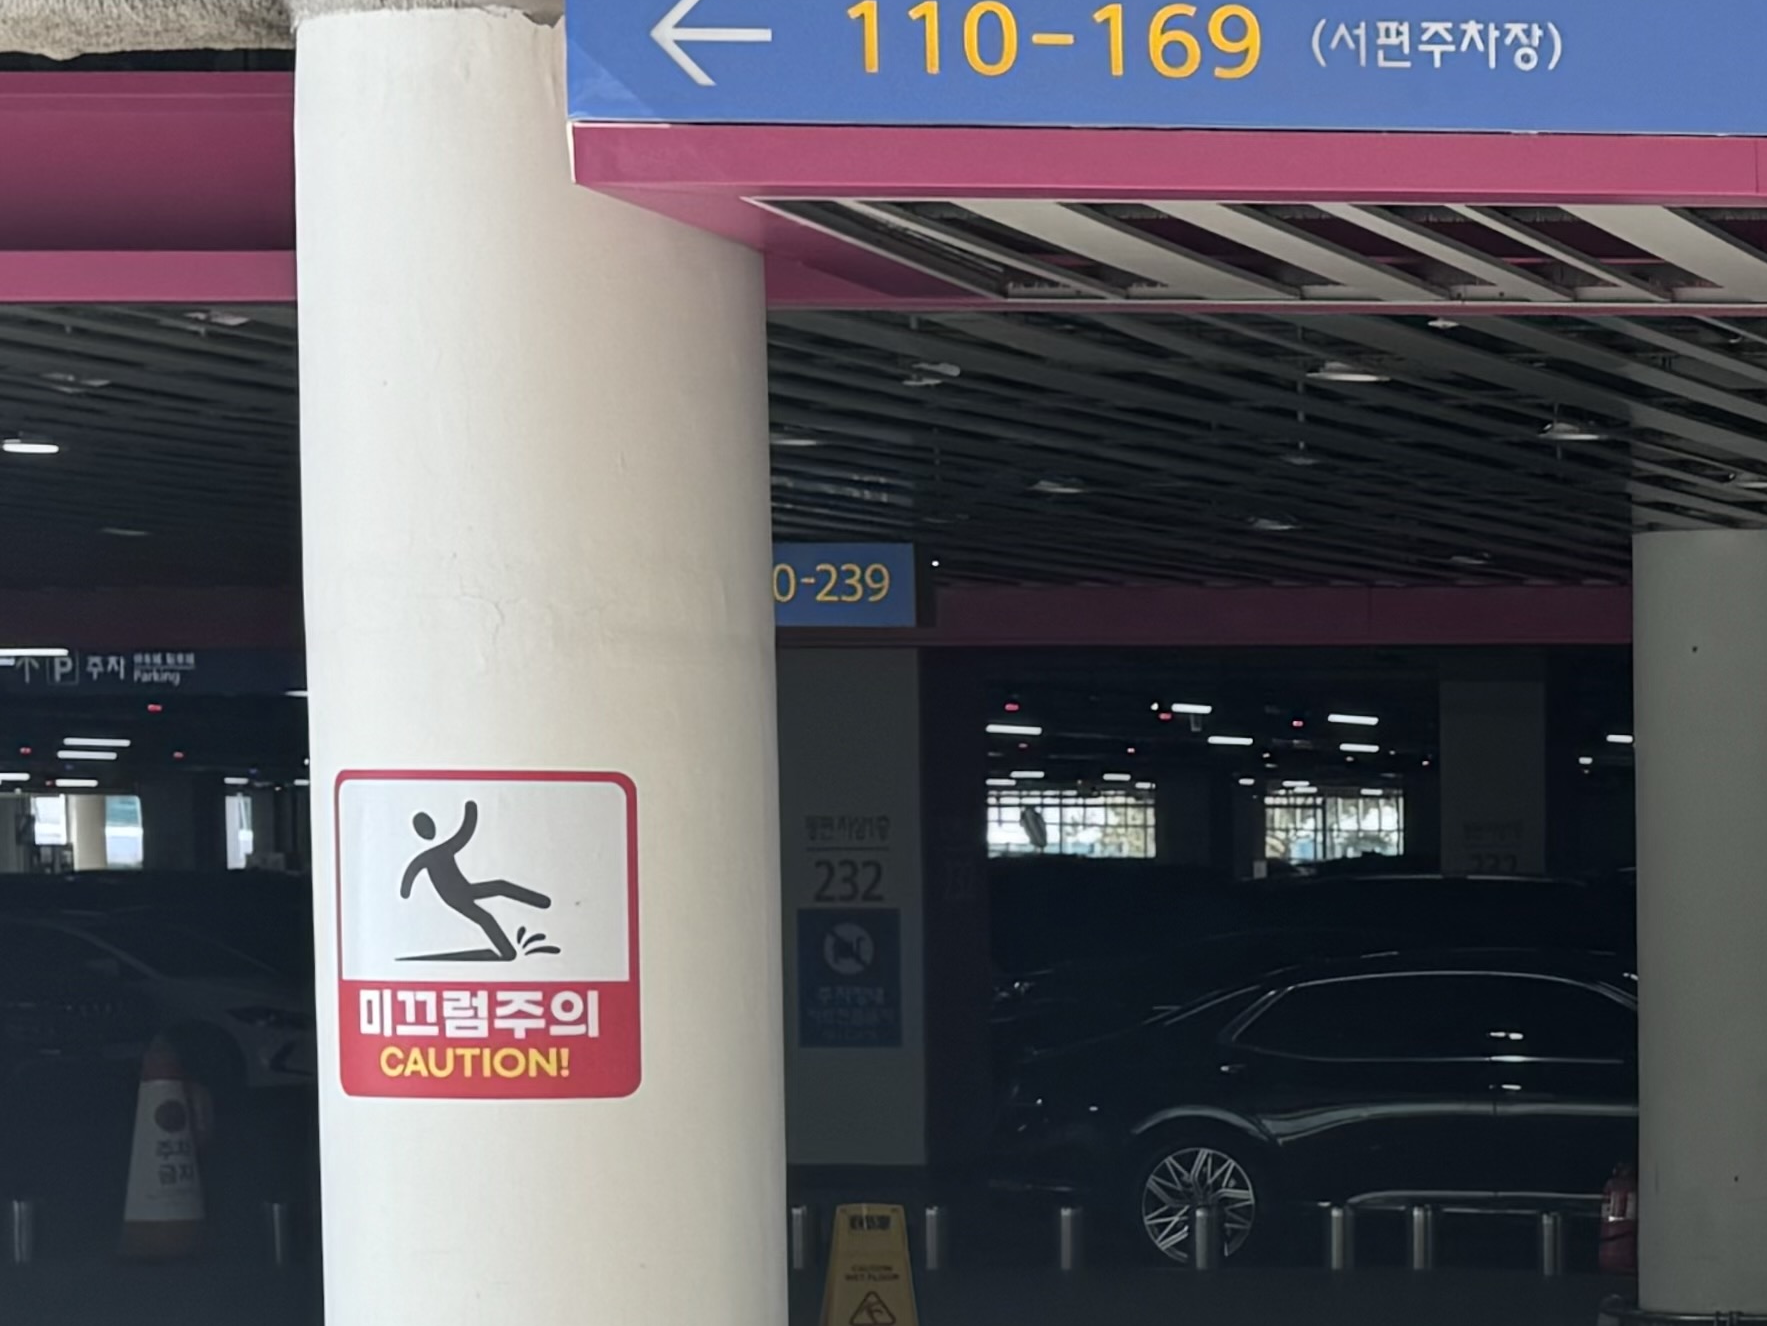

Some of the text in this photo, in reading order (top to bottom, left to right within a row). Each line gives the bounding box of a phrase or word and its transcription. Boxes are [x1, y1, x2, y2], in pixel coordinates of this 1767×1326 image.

[1311, 18, 1563, 72] (서편주차장)
[813, 858, 885, 903] 232
[359, 988, 599, 1040] 미끄럼주의
[380, 1045, 570, 1078] CAUTION!
